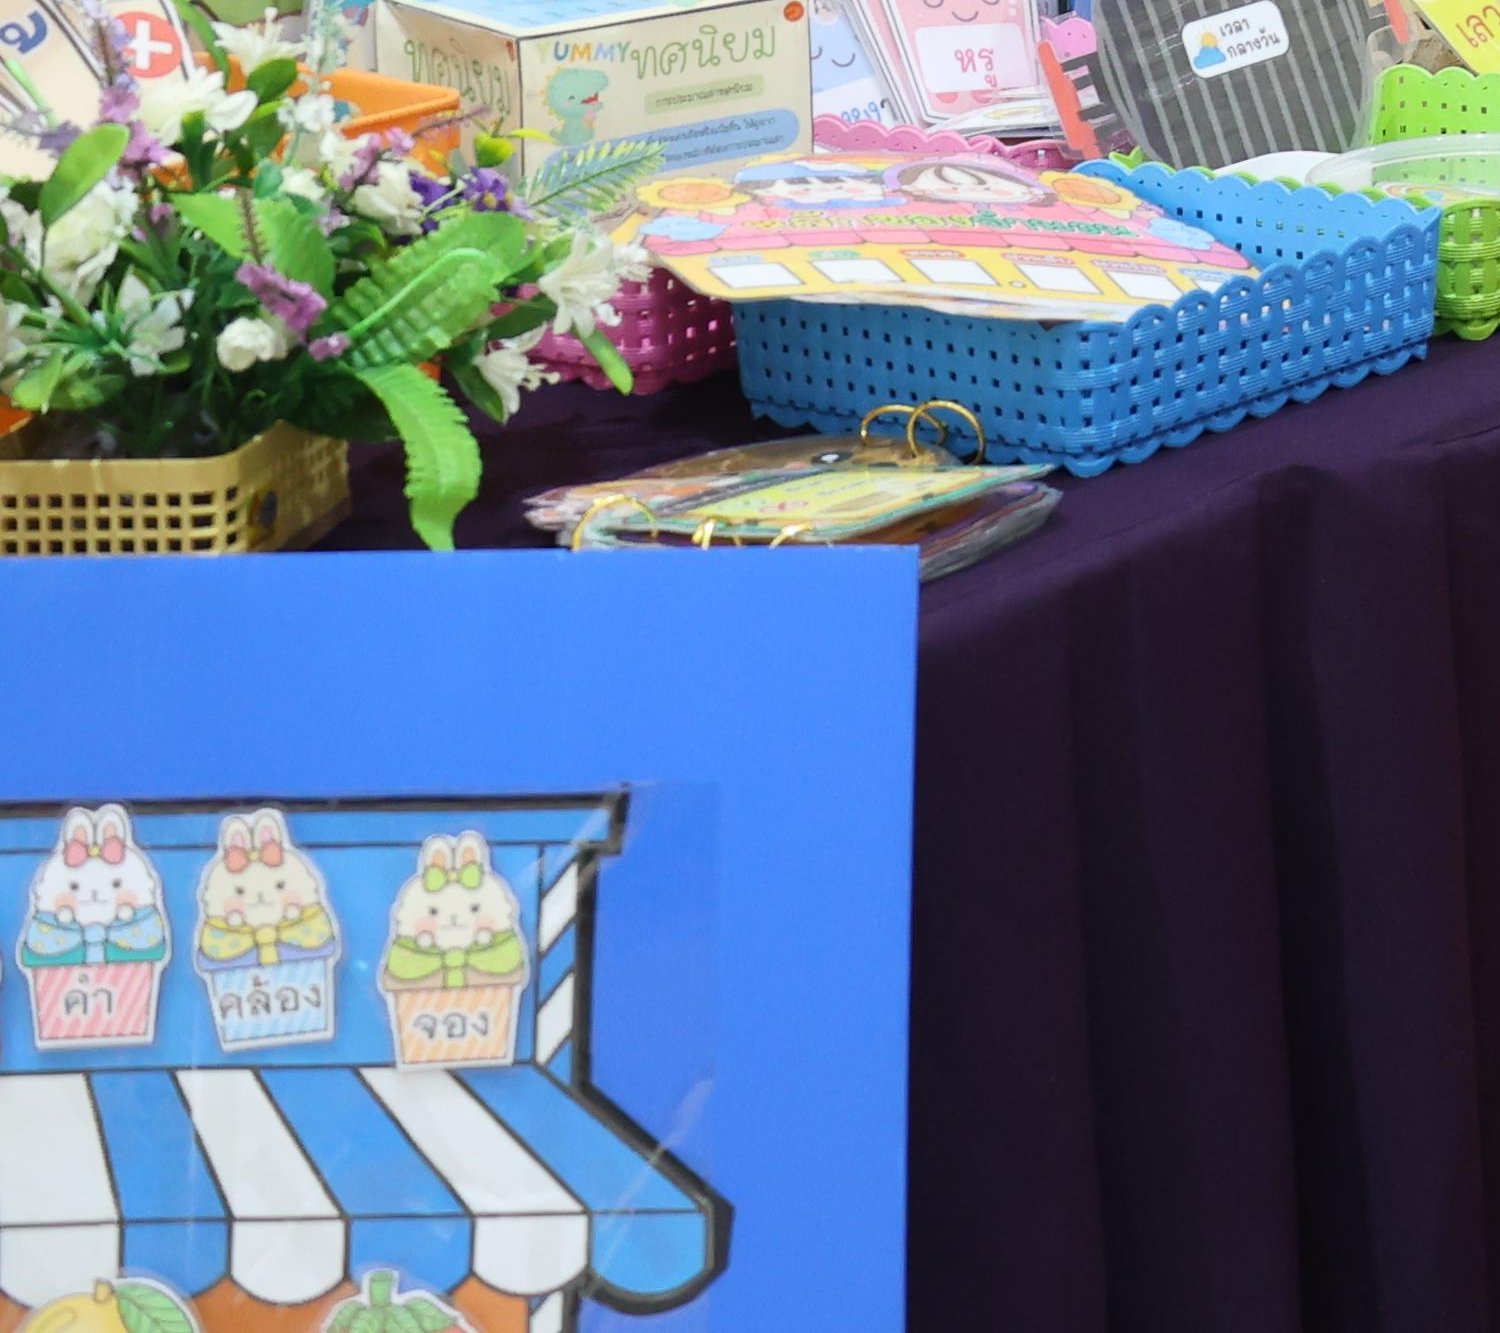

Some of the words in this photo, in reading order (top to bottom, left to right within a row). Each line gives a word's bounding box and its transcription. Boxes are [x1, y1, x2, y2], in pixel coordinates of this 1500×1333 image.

[1219, 18, 1250, 37] เวลา
[1226, 27, 1281, 59] กลางวัน
[536, 40, 630, 64] YUMMY
[629, 24, 777, 81] ทศนิยม
[953, 46, 999, 89] หรู
[62, 973, 117, 1019] คำ
[217, 976, 324, 1024] คล้อง
[411, 1007, 491, 1041] จอง
